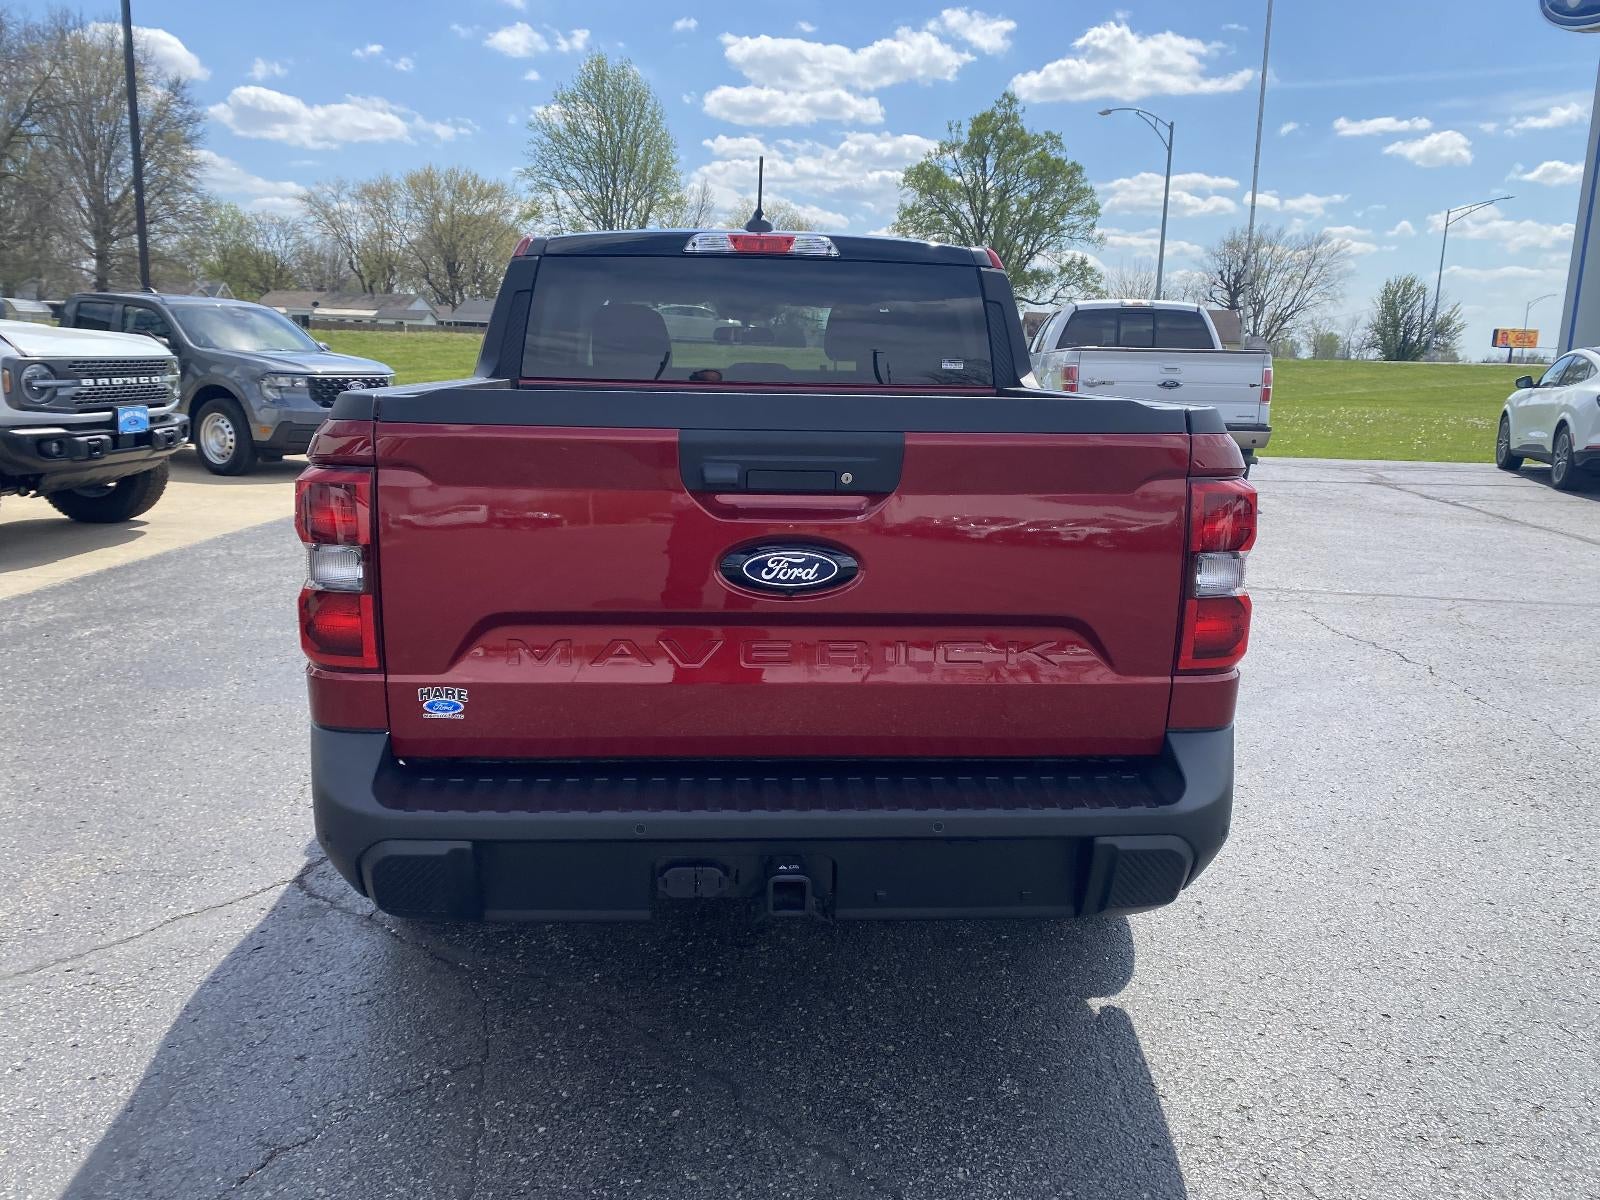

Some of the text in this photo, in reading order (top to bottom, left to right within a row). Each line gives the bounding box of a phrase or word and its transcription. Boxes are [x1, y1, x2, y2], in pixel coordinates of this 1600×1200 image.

[82, 377, 161, 386] BRONCO
[761, 556, 819, 580] Ford
[506, 638, 1060, 668] MAVERICK
[418, 687, 468, 702] HARE
[432, 701, 454, 711] Ford
